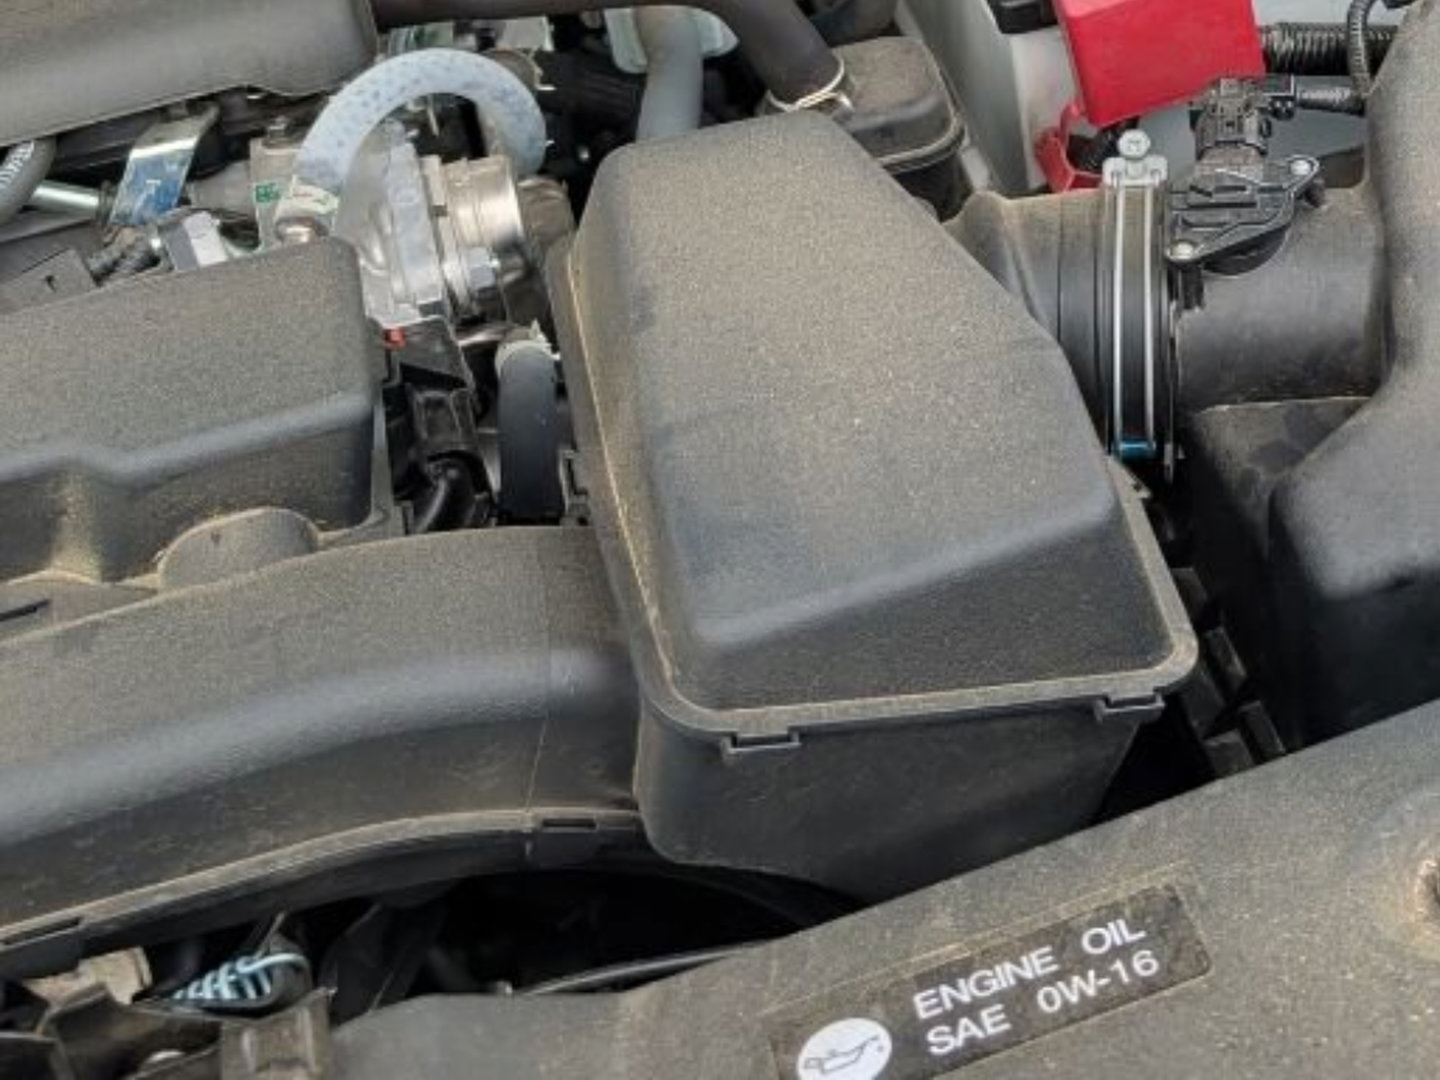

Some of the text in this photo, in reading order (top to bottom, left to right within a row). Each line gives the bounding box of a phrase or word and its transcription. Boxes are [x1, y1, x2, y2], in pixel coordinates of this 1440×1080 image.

[913, 919, 1147, 1019] ENGINE OIL
[926, 950, 1160, 1056] SAE 0W-16
